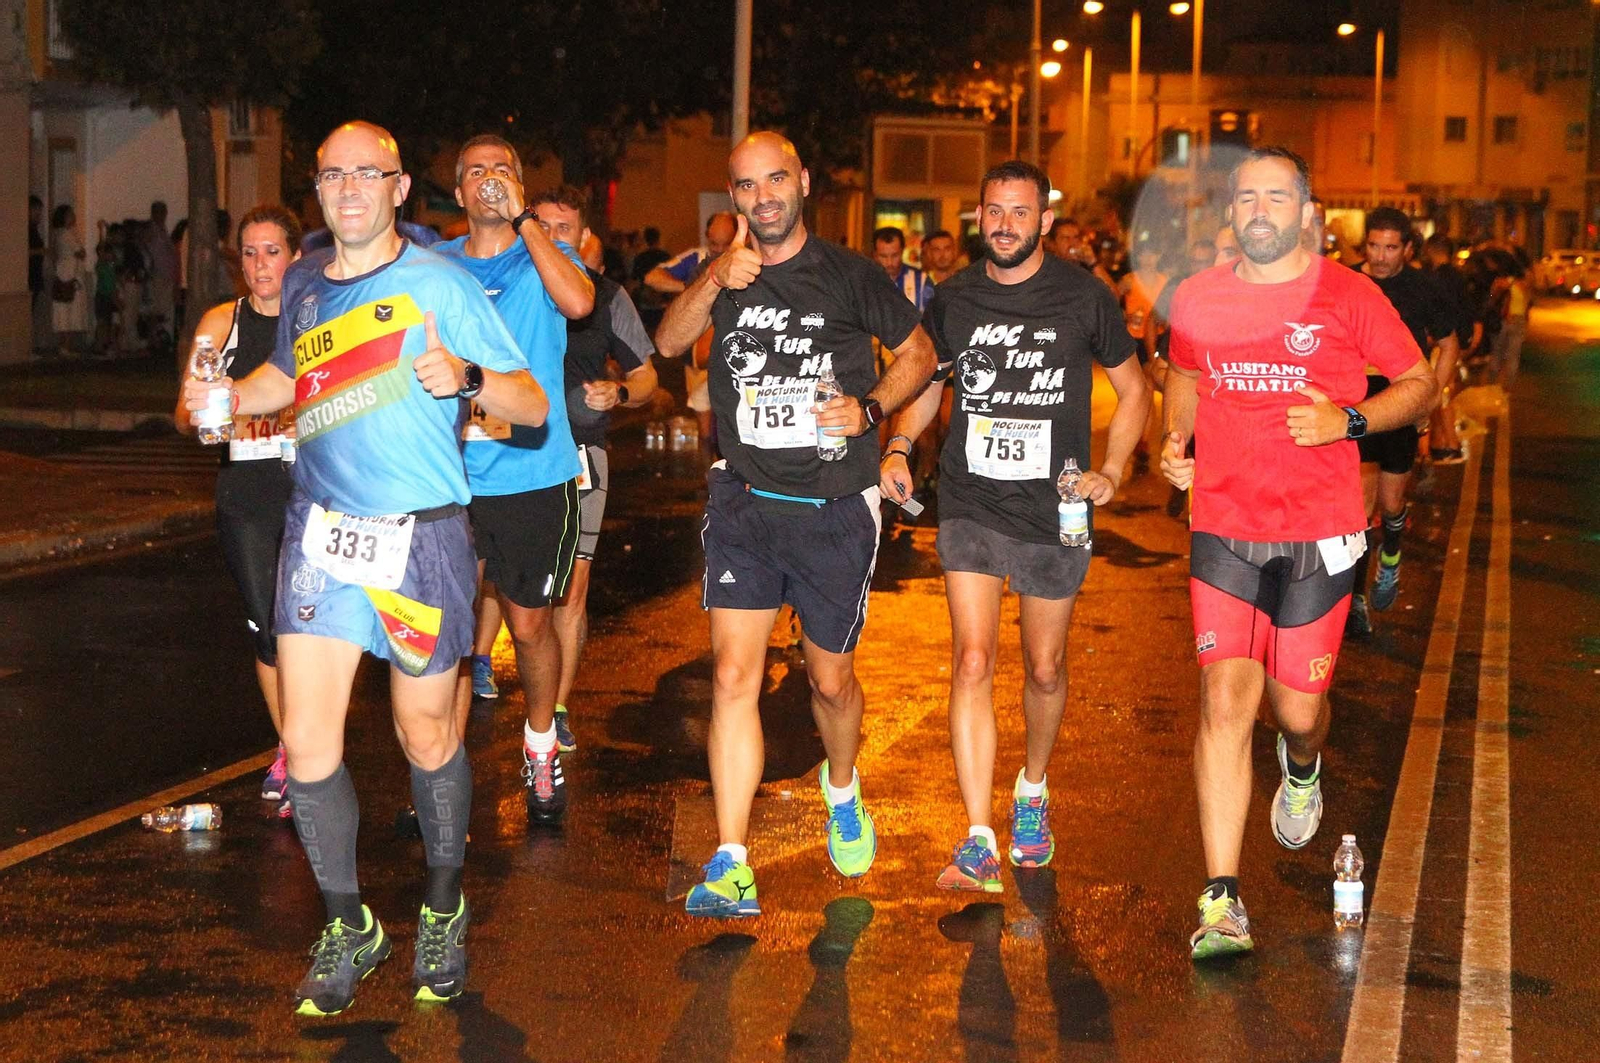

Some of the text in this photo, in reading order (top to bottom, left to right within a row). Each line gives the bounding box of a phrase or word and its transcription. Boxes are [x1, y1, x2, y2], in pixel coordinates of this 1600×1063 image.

[736, 304, 791, 331] NOC
[773, 334, 813, 355] TUR
[968, 322, 1025, 347] NOC
[296, 330, 334, 366] CLUB
[799, 352, 834, 376] NA
[1004, 349, 1046, 370] TUR
[1220, 362, 1307, 377] LUSITANO
[1029, 366, 1066, 391] NA
[755, 394, 808, 406] DE HUELVA
[756, 385, 809, 398] NOCTURNA
[991, 391, 1012, 405] DE
[1013, 390, 1066, 406] HUELVA
[750, 404, 796, 429] 752
[992, 420, 1042, 431] NOCTURNA
[989, 428, 1040, 438] DE HUELVA
[983, 436, 1026, 461] 753
[325, 527, 378, 562] 333
[394, 607, 415, 623] CLUB
